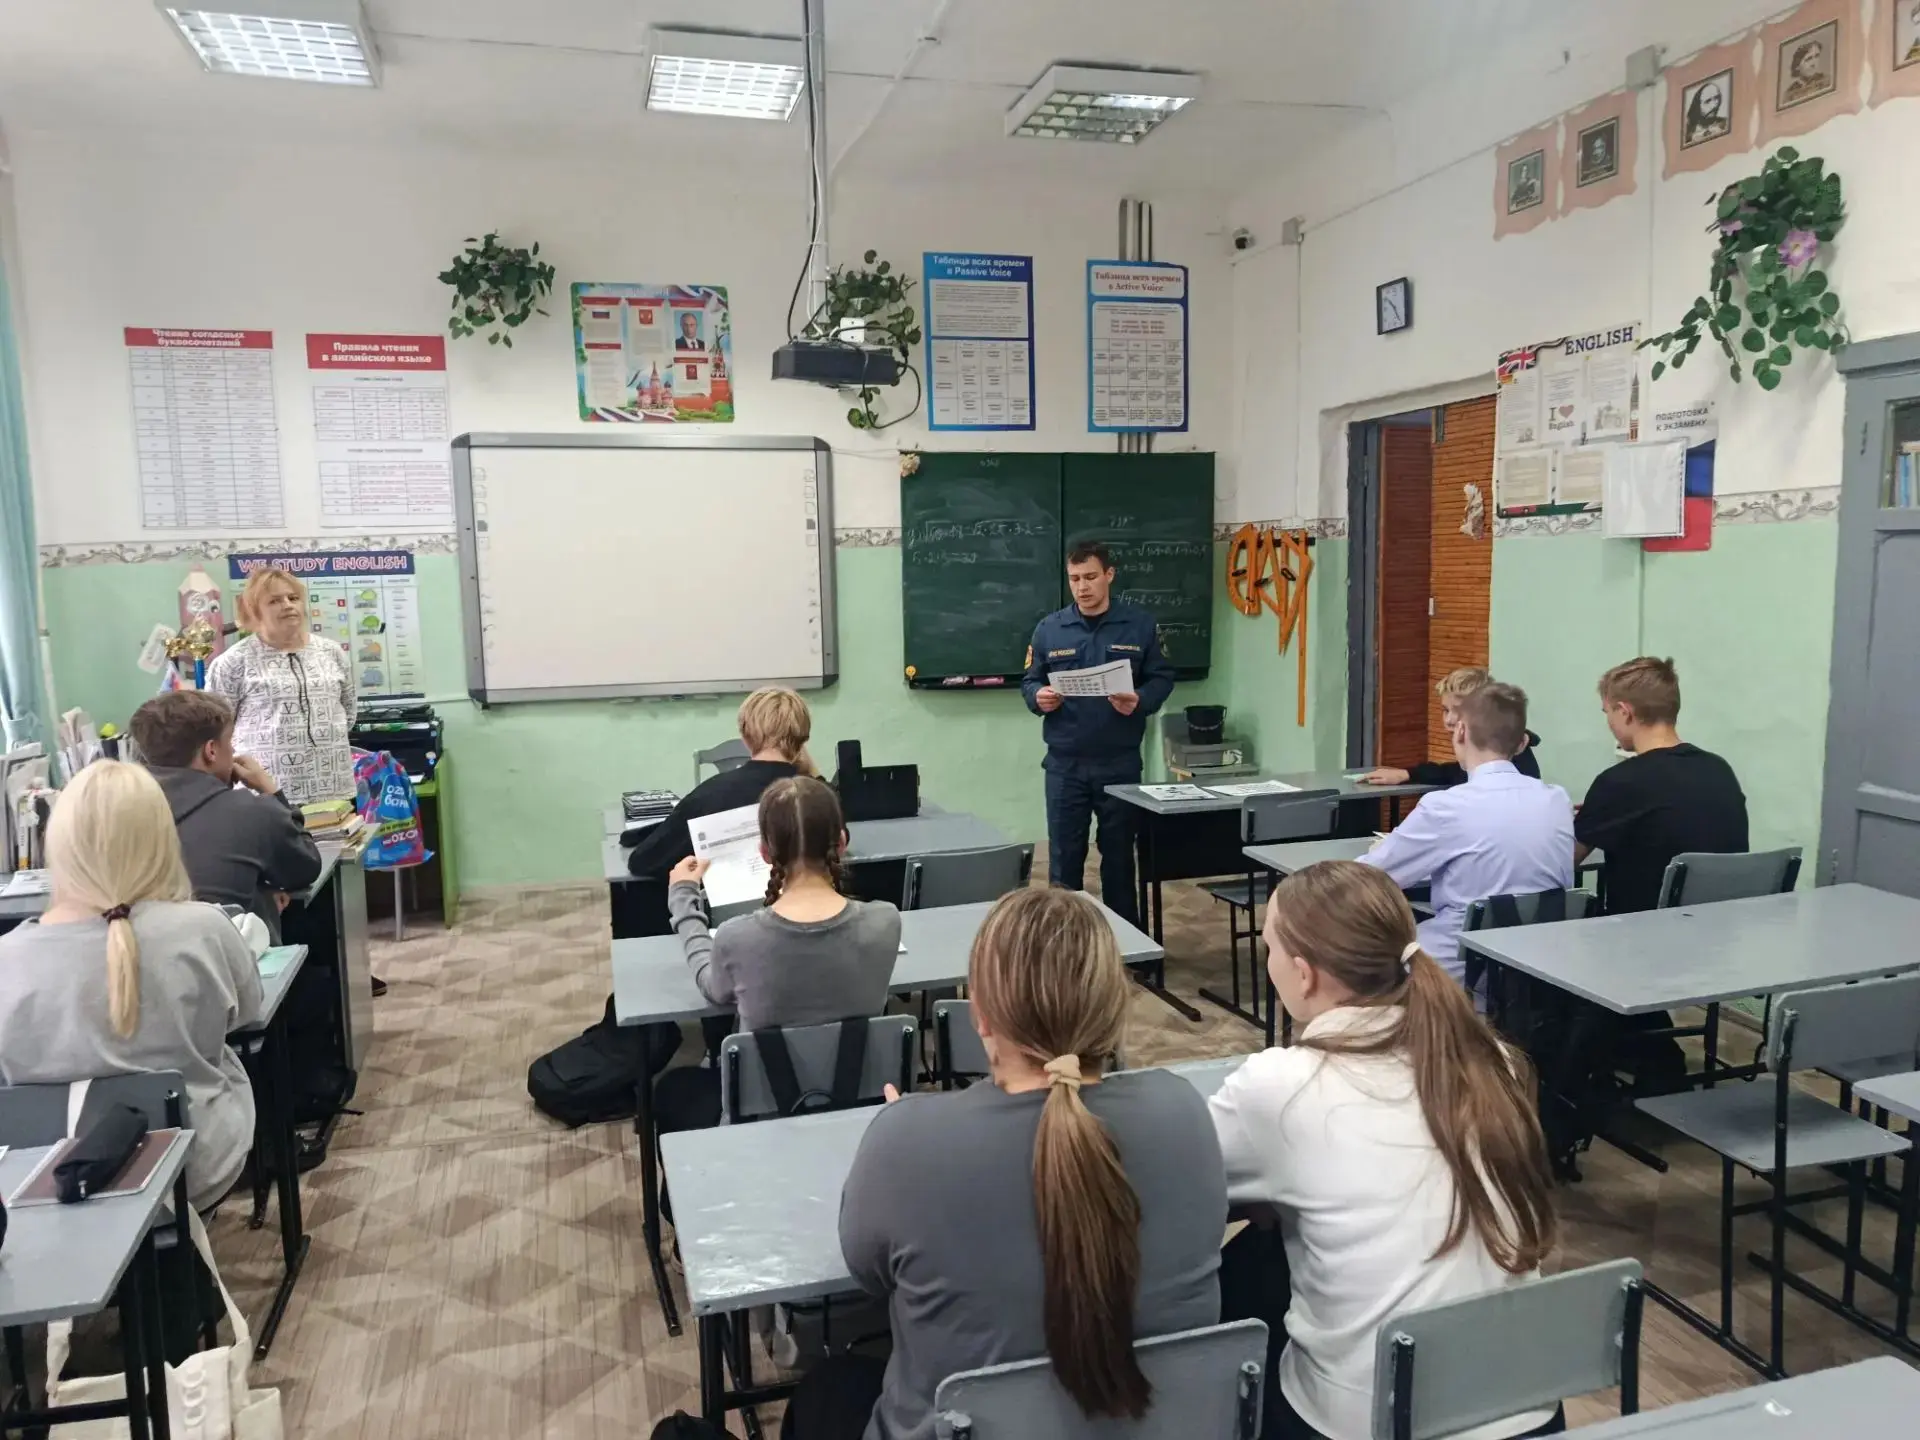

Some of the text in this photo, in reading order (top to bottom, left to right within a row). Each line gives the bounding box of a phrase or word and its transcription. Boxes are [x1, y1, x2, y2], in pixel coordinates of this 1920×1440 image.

[933, 256, 1025, 268] Таблица всех времен
[954, 267, 988, 276] Passive
[989, 268, 1012, 277] Voice
[1095, 271, 1131, 282] Таблица
[1115, 283, 1140, 291] Active
[1141, 284, 1164, 292] Voice
[152, 328, 245, 339] Чтение согласных
[157, 338, 241, 348] буквосочетаний
[1564, 326, 1634, 356] ENGLISH
[333, 341, 420, 353] Правила чтения
[331, 352, 396, 363] английском
[397, 355, 433, 364] языке
[1655, 407, 1709, 421] ПОДГОТОВКА
[1548, 420, 1575, 431] English
[1663, 418, 1708, 431] ЭКЗАМЕНУ
[271, 557, 329, 572] STUDY
[332, 555, 408, 570] ENGLISH
[282, 766, 305, 776] VANT
